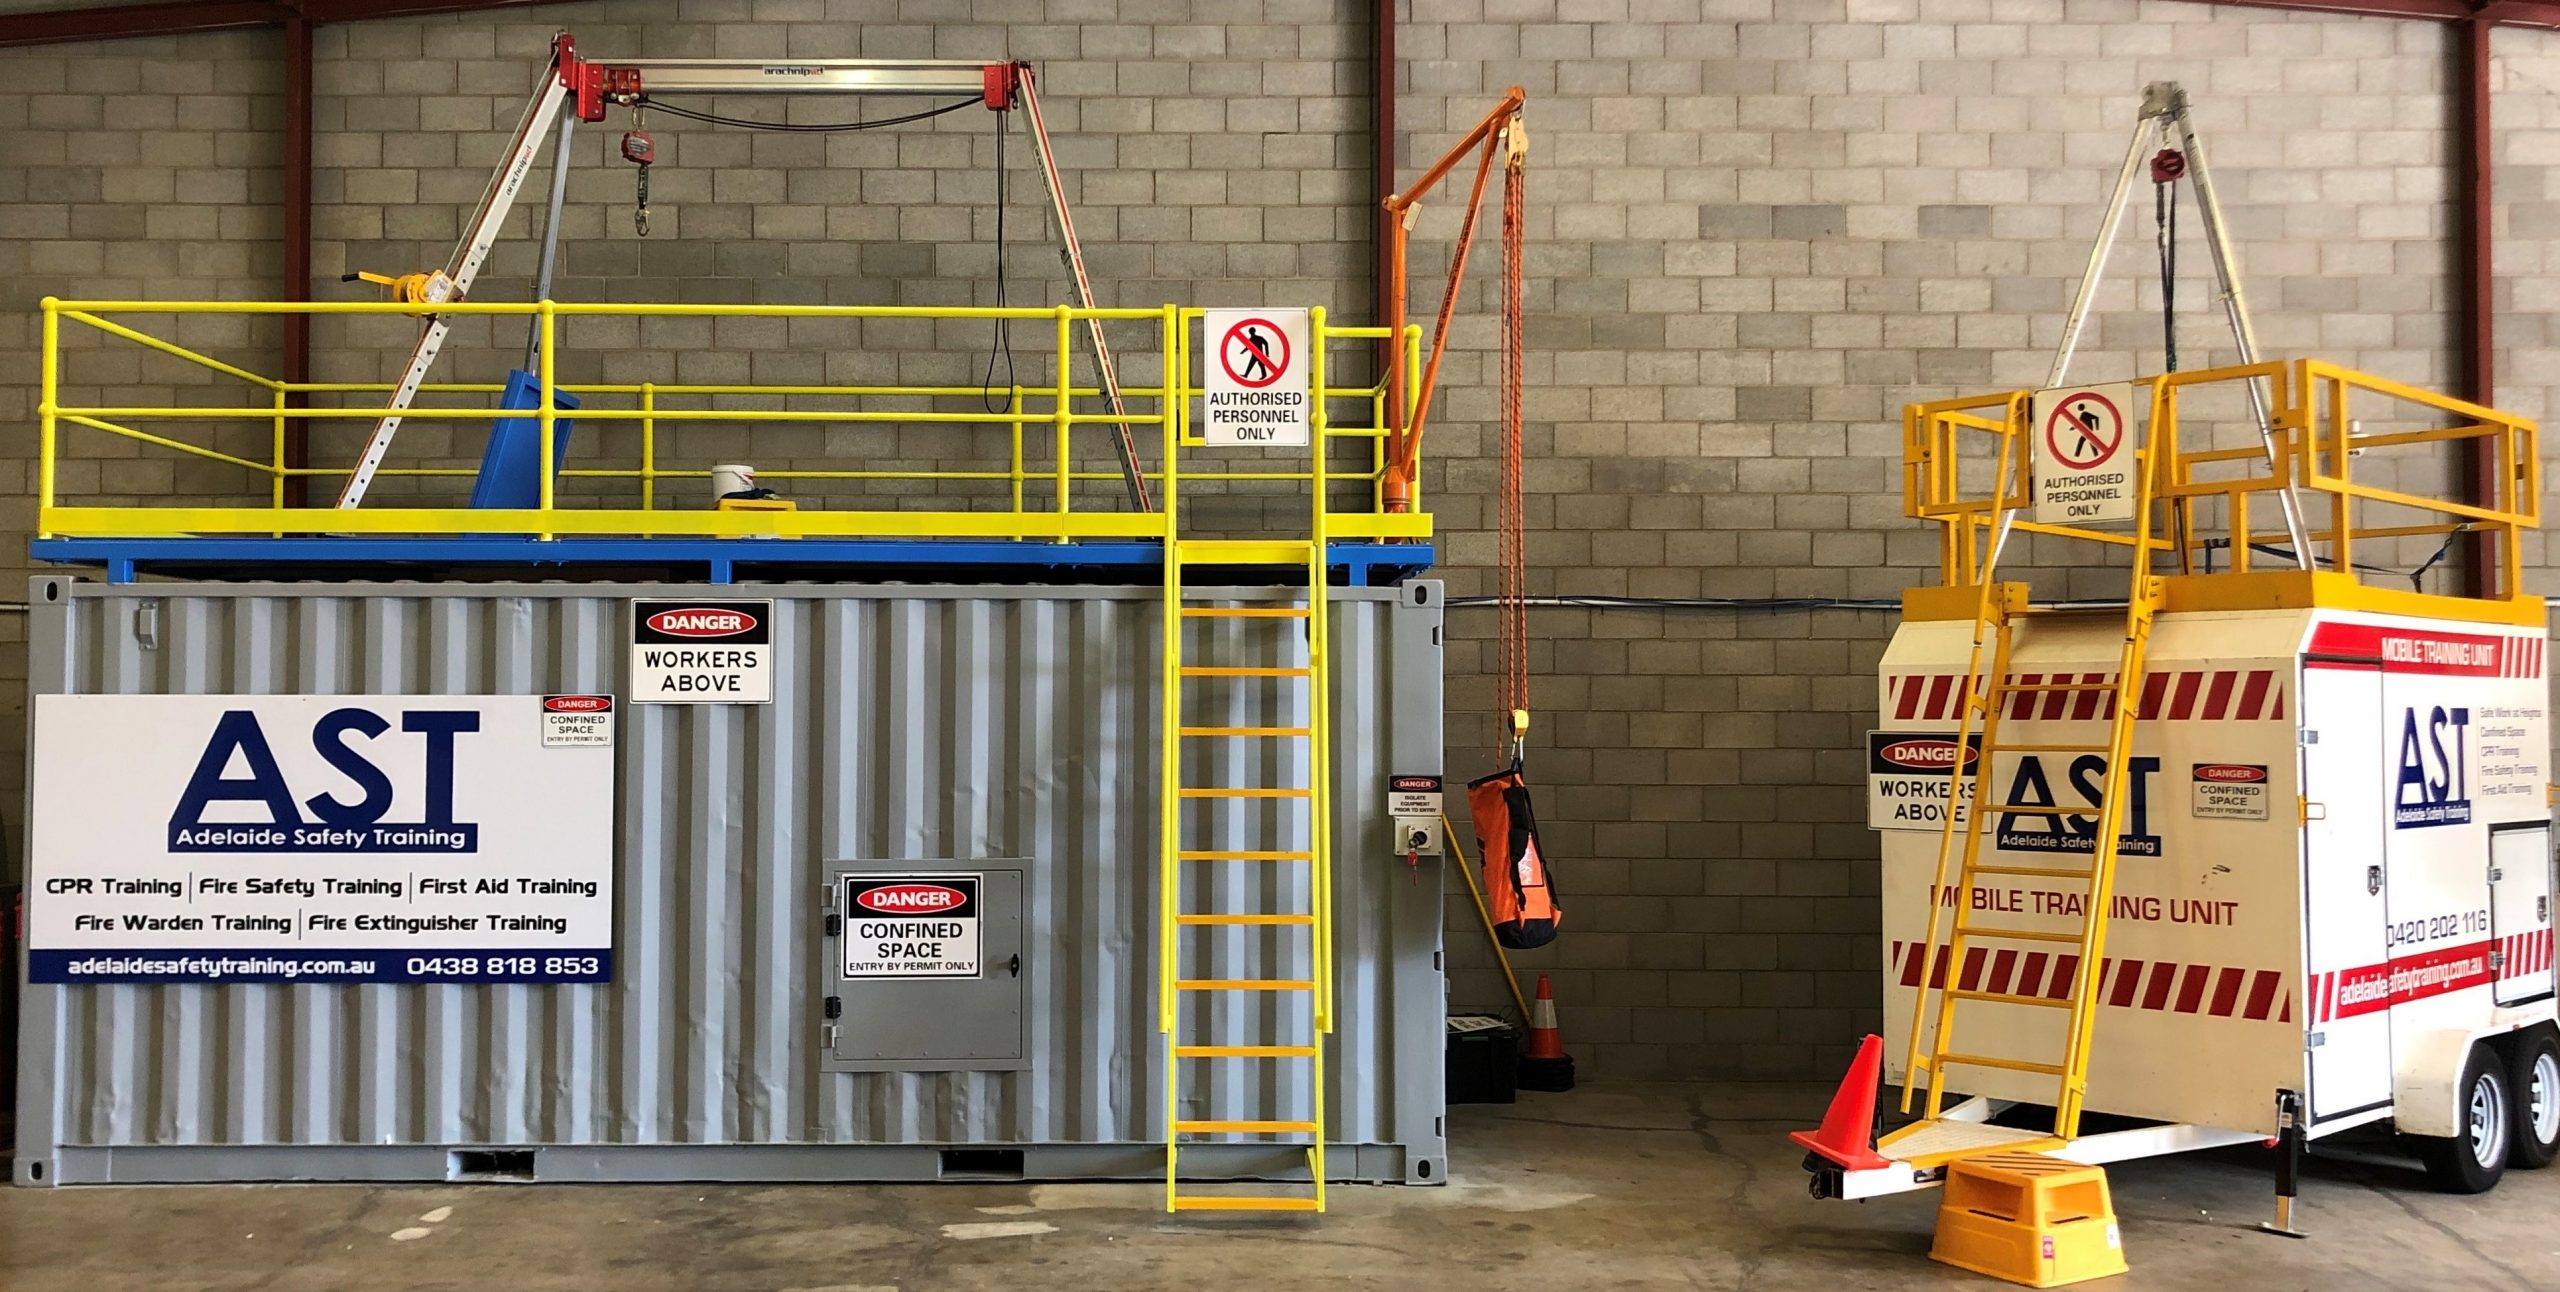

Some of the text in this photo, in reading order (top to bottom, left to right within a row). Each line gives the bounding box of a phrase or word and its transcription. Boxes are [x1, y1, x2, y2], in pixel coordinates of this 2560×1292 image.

[1210, 392, 1302, 405] AUTHORISED
[1213, 410, 1299, 423] PERSONNEL
[1236, 427, 1275, 440] ONLY
[2044, 473, 2124, 489] AUTHORISED
[2047, 488, 2121, 503] PERSONNEL
[2067, 504, 2100, 516] ONLY
[662, 615, 742, 630] DANGER
[645, 651, 757, 668] WORKERS
[2381, 637, 2495, 666] MOBILE TRAINING UNIT
[661, 675, 741, 692] ABOVE
[558, 700, 598, 708] DANGER
[550, 715, 606, 724] CONFINED
[558, 725, 594, 734] SPACE
[2395, 705, 2469, 804] AST
[169, 708, 480, 824] AST
[2208, 769, 2251, 778] DANGER
[1997, 754, 2160, 834] AST
[2200, 785, 2260, 796] CONFINED
[2209, 796, 2248, 806] SPACE
[176, 828, 466, 849] Adelaide Safety Training
[2000, 834, 2057, 847] Adelaide
[46, 878, 598, 897] CPR Training Fire Safety Training First Aid Training
[873, 891, 952, 907] DANGER
[2030, 891, 2161, 921] TRAIING
[2169, 898, 2239, 926] UNIT
[75, 915, 567, 934] Fire Warden Training Fire Extinguisher Training
[860, 922, 963, 939] CONFINED
[2387, 909, 2487, 948] 0420 202 116
[877, 942, 943, 959] SPACE
[68, 957, 599, 978] adelaidesafetytraining.com.au 0438 818 853
[849, 961, 974, 971] ENTRY BY PERMIT ONLY
